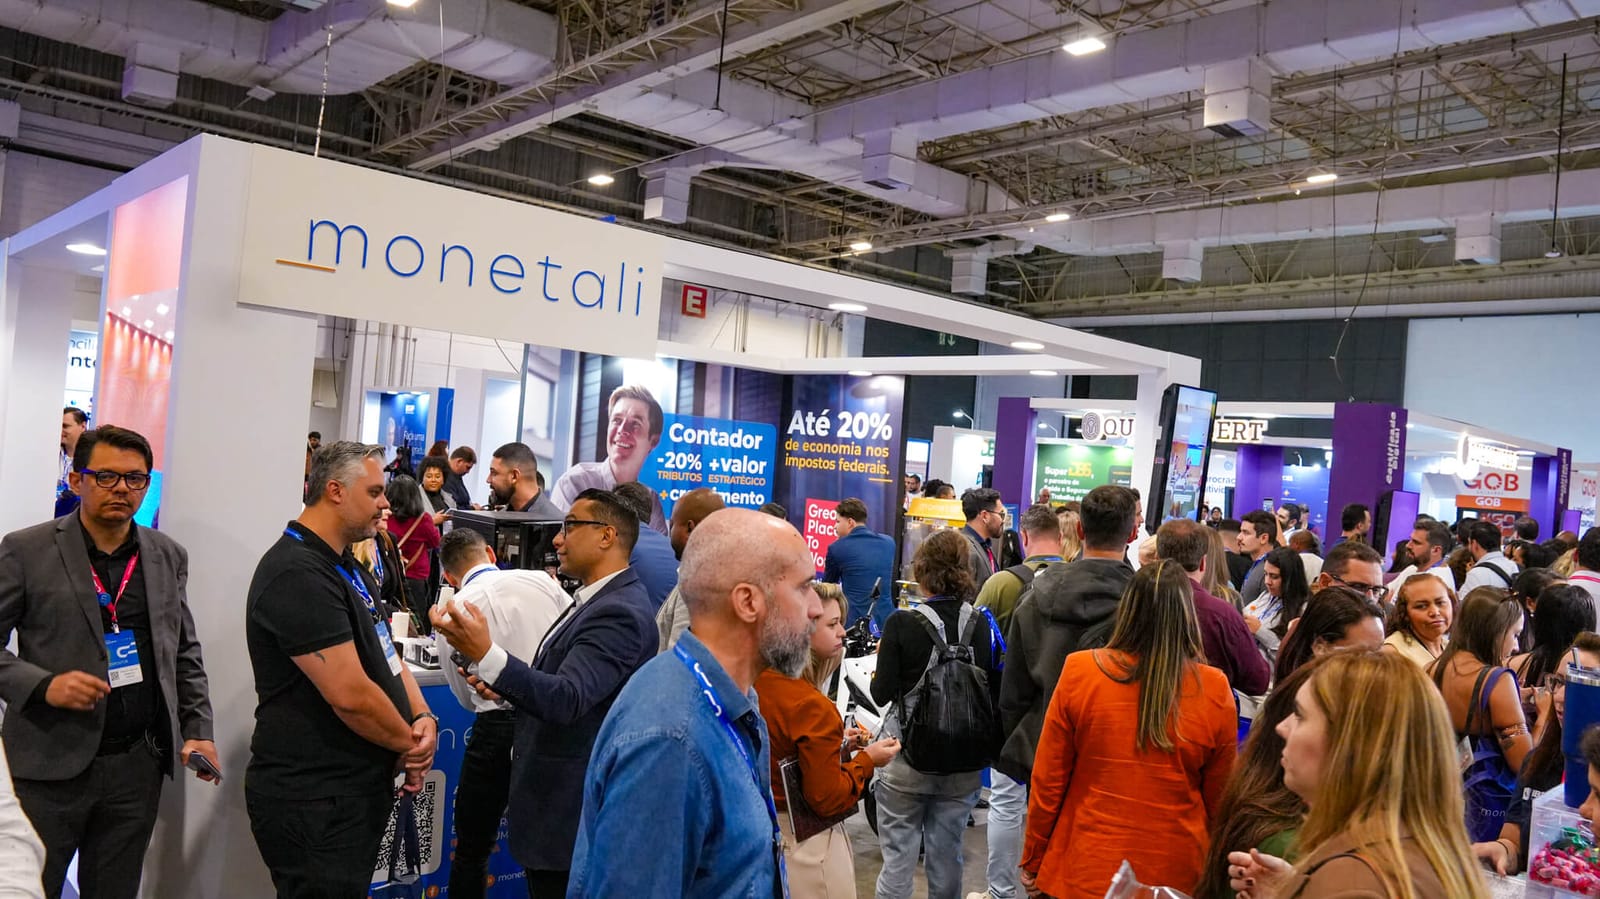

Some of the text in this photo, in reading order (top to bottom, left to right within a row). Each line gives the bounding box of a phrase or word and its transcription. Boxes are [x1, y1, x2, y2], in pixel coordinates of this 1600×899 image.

[307, 218, 644, 316] monetali
[686, 289, 703, 314] E
[668, 422, 763, 450] Contador
[786, 409, 893, 441] Até 20%
[785, 438, 889, 458] de economia nos
[657, 451, 767, 475] -20% +valor
[785, 453, 890, 475] impostos federais.
[657, 470, 766, 487] TRIBUTOS ESTRATÉGICO
[1475, 496, 1501, 507] GOB
[806, 535, 819, 550] To
